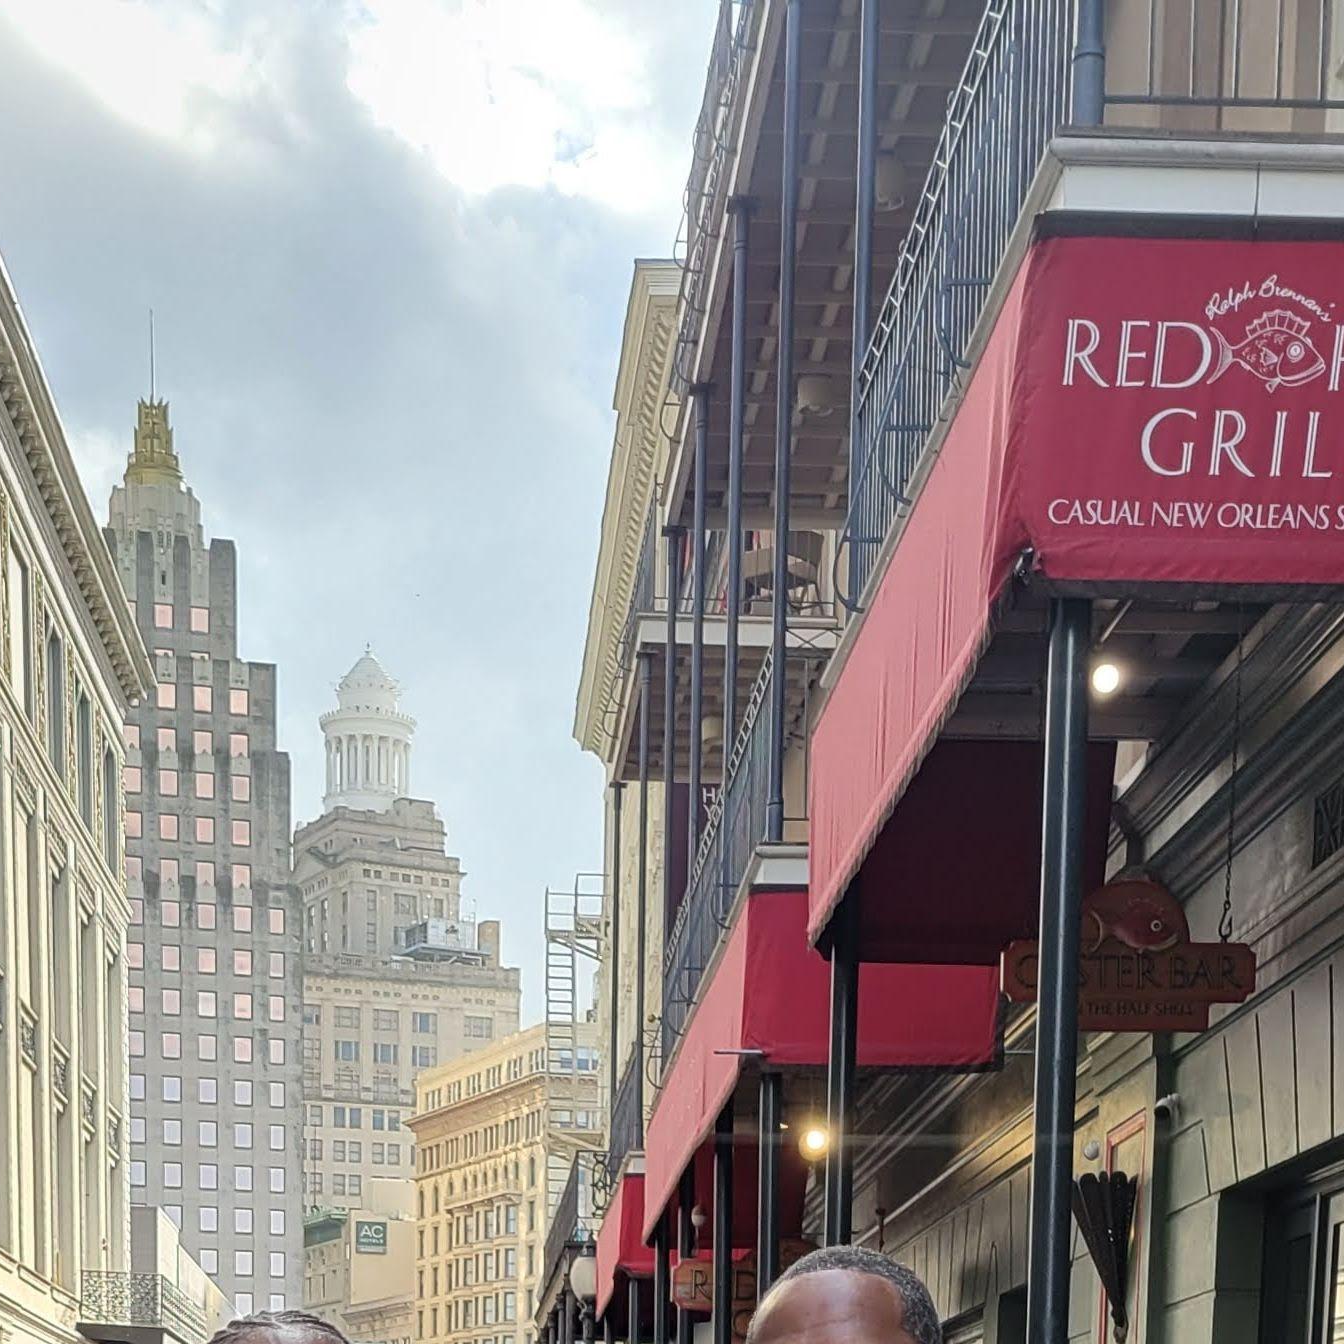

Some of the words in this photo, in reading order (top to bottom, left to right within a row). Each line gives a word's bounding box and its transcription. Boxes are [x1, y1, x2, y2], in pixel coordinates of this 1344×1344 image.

[1205, 281, 1256, 320] Ralph
[1259, 274, 1336, 322] Brennan's
[1062, 319, 1213, 389] RED
[1048, 499, 1144, 527] CASUAL
[1151, 501, 1213, 529] NEW
[1217, 503, 1330, 530] ORLEANS
[1014, 953, 1160, 990] OSTER
[1169, 954, 1243, 990] BAR
[360, 1225, 384, 1238] AC
